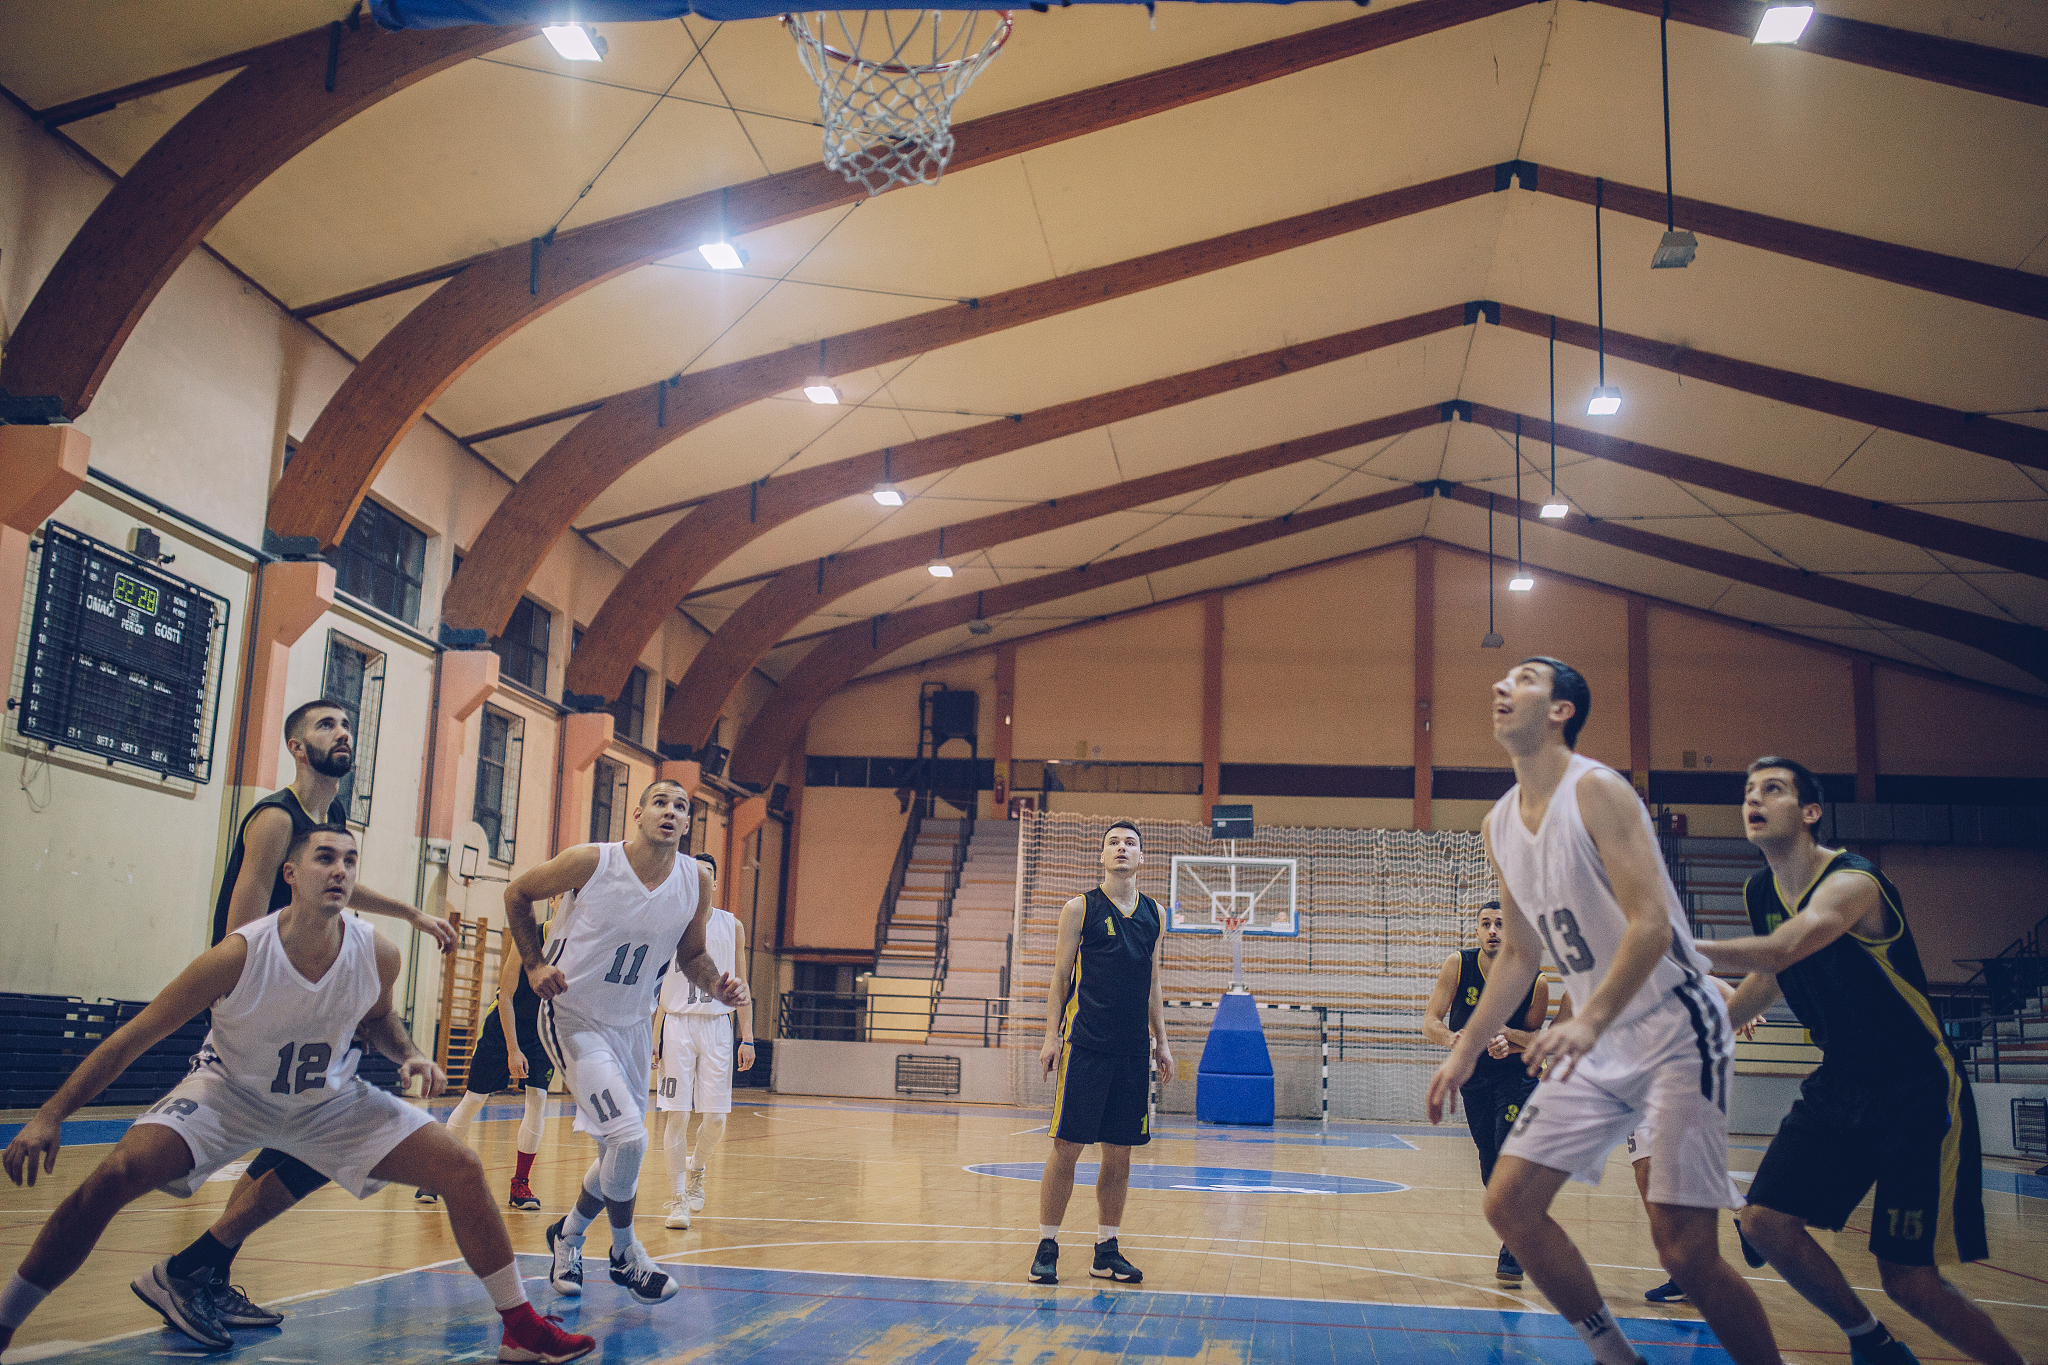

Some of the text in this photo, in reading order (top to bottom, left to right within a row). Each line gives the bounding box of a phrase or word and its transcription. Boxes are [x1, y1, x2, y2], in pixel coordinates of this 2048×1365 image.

[155, 621, 181, 644] GOSTI
[34, 665, 43, 678] 12
[32, 682, 41, 694] 13
[30, 699, 38, 711] 14
[28, 716, 36, 728] 15
[194, 718, 200, 729] 12
[96, 735, 115, 749] SET 2
[121, 742, 139, 756] SET 3
[151, 750, 168, 763] SET 4
[190, 747, 197, 759] 14
[188, 762, 195, 773] 15
[1104, 916, 1116, 936] 1
[1538, 908, 1596, 974] 13
[603, 942, 649, 986] 11
[1465, 986, 1479, 1006] 3
[270, 1041, 332, 1095] 12
[658, 1077, 678, 1099] 10
[589, 1088, 622, 1123] 11
[1504, 1104, 1519, 1123] 3
[1887, 1208, 1924, 1241] 15
